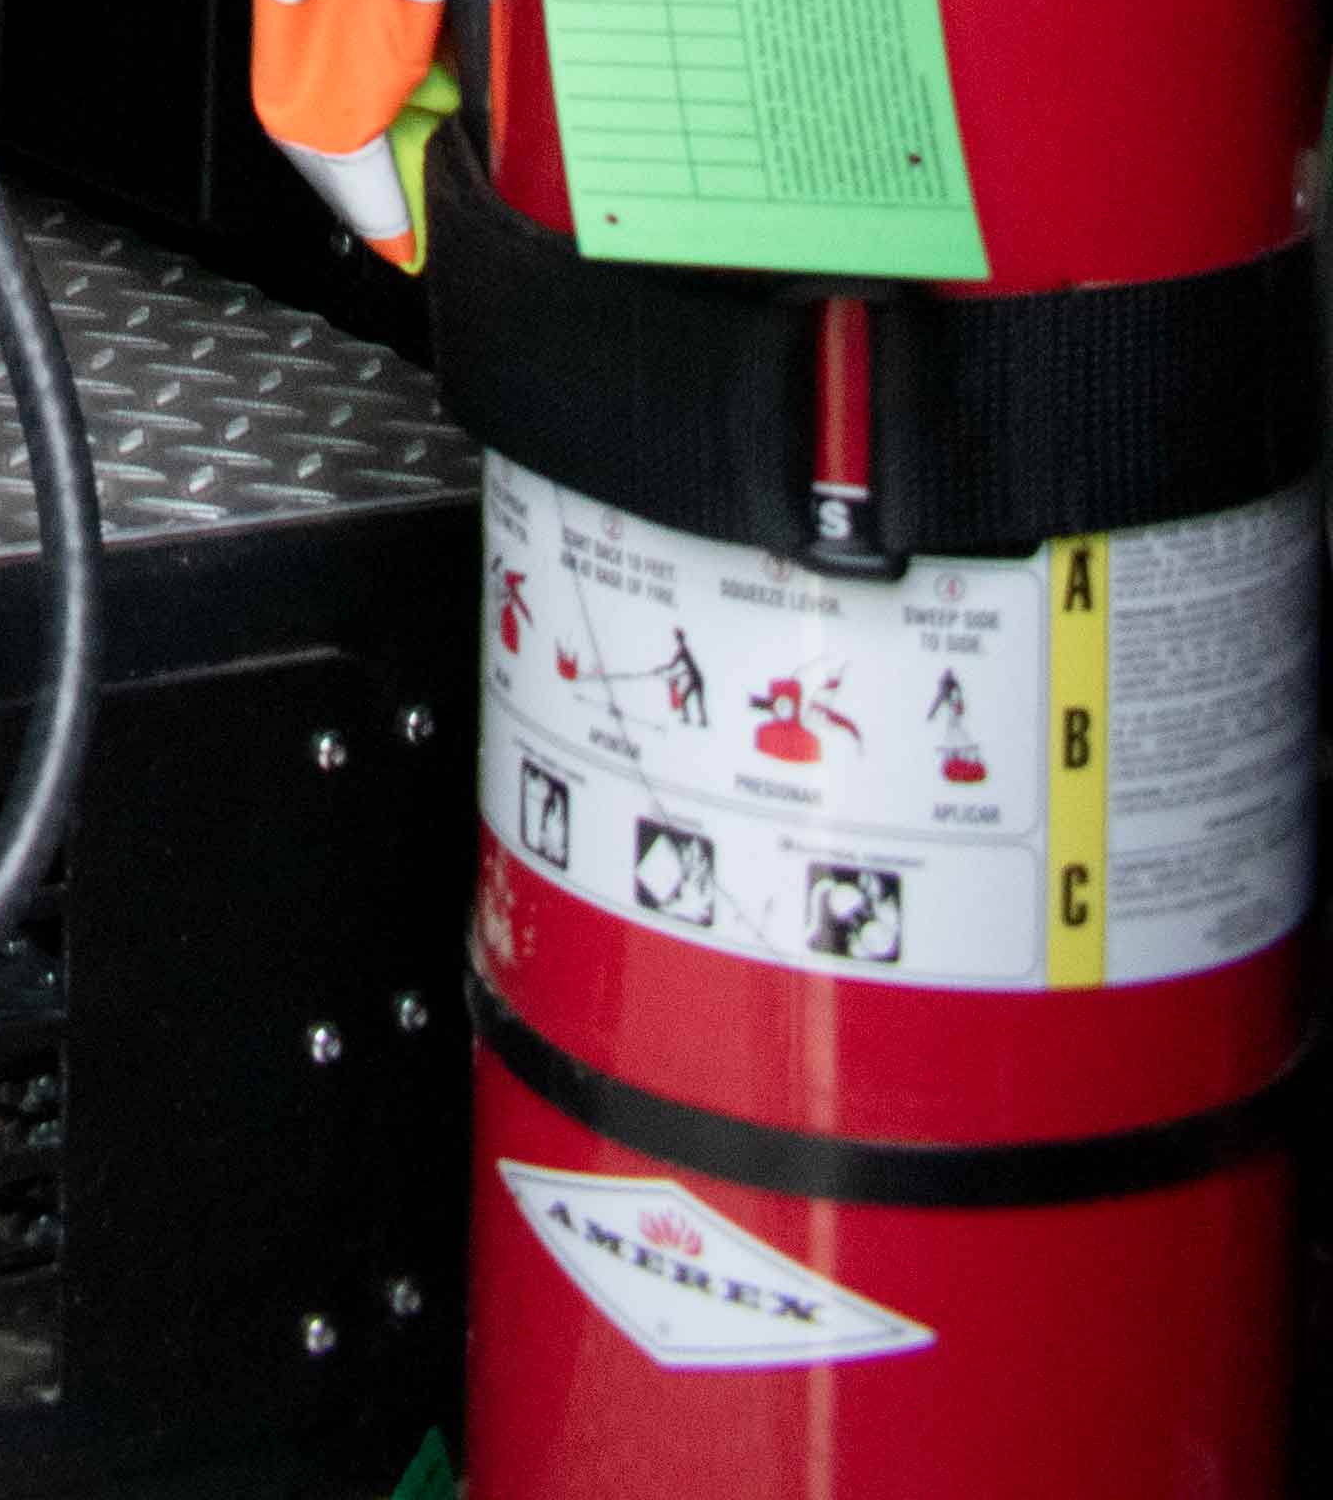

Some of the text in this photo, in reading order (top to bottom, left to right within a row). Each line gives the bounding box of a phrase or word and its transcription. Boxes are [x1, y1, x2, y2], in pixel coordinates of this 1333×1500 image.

[1062, 547, 1094, 613] A
[1063, 707, 1091, 770] B
[1060, 862, 1089, 928] C
[545, 1199, 822, 1325] AMEREX
